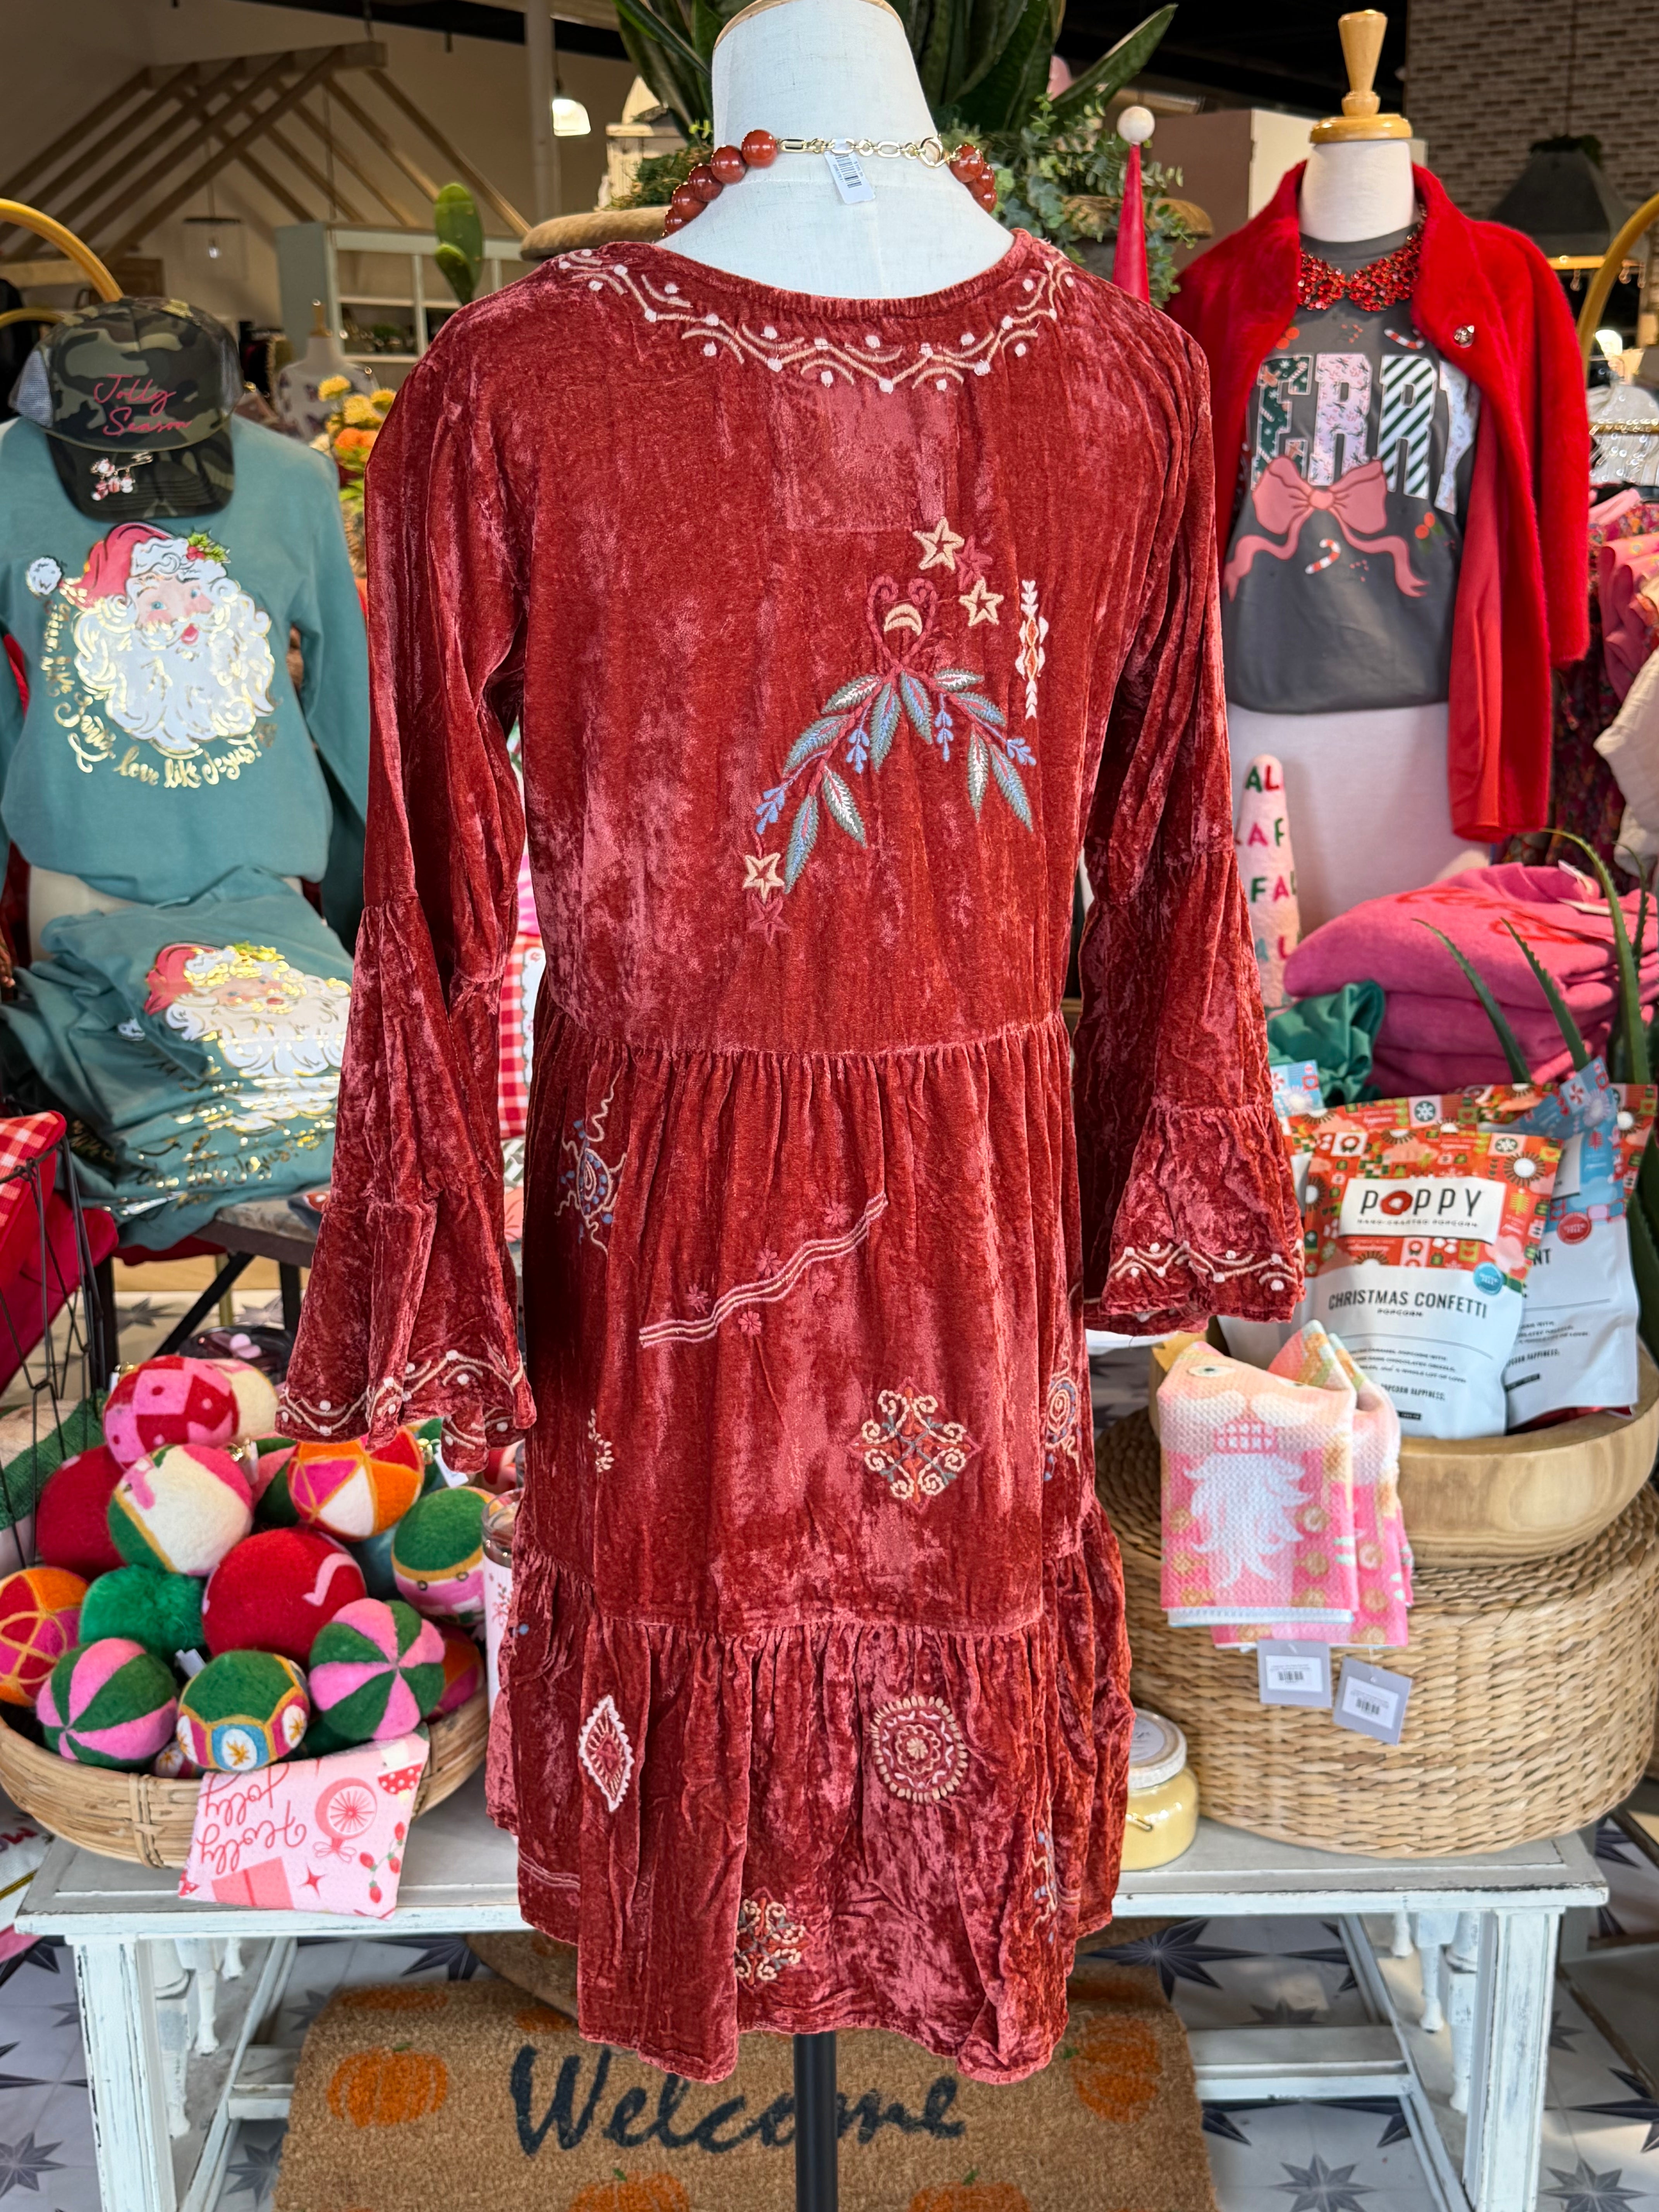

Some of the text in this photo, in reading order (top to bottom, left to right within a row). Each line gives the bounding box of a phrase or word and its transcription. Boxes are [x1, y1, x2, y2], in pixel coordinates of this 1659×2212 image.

[93, 374, 176, 417] Jolly
[103, 407, 192, 436] Season
[1246, 353, 1480, 515] ERRY
[113, 745, 160, 786] love
[163, 758, 202, 789] like
[1360, 1188, 1482, 1217] POPPY
[1329, 1290, 1488, 1318] CHRISTMAS CONFETTI
[1377, 1308, 1423, 1317] POPCORN
[195, 1800, 307, 1875] Holly
[509, 2042, 966, 2157] Welcome
